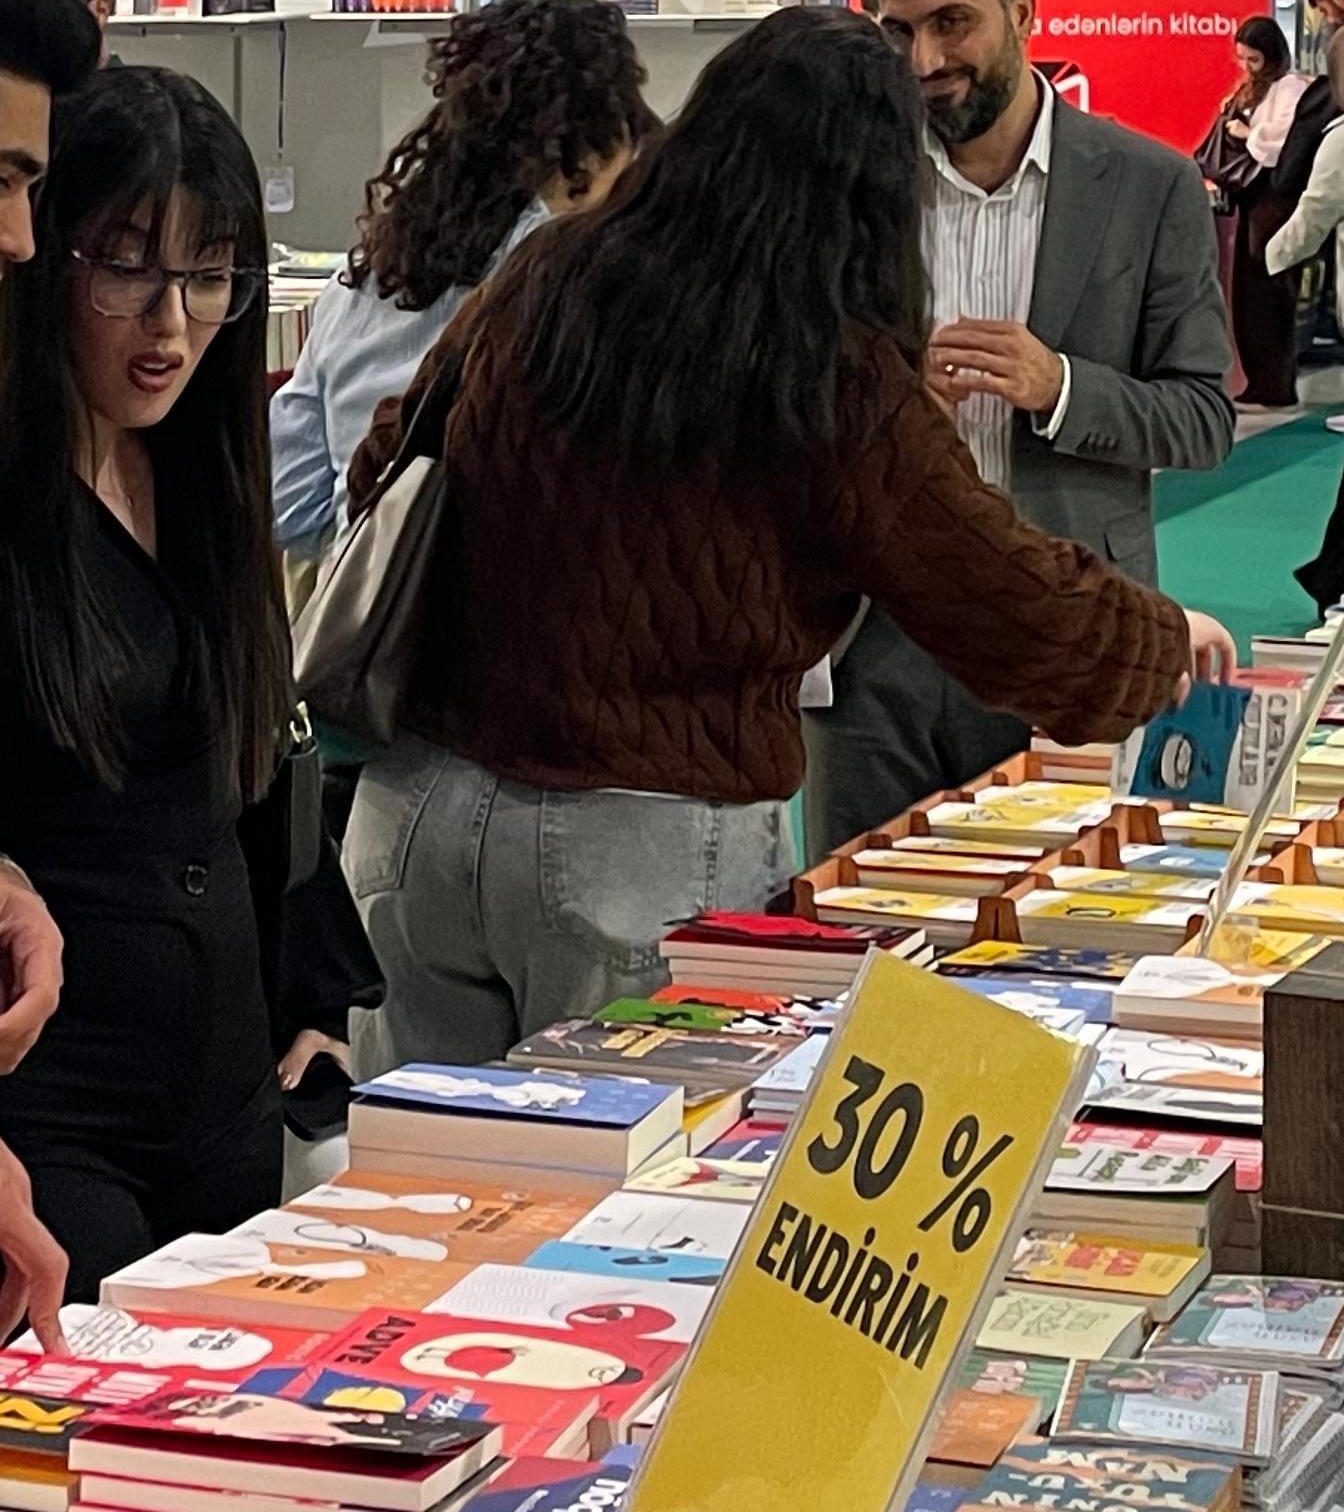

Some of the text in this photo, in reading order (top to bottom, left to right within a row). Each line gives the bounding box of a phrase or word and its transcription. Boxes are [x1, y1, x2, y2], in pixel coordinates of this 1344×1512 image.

[1048, 11, 1164, 36] edənlərin
[807, 1054, 1014, 1253] 30 %
[756, 1201, 949, 1370] ENDİRİM
